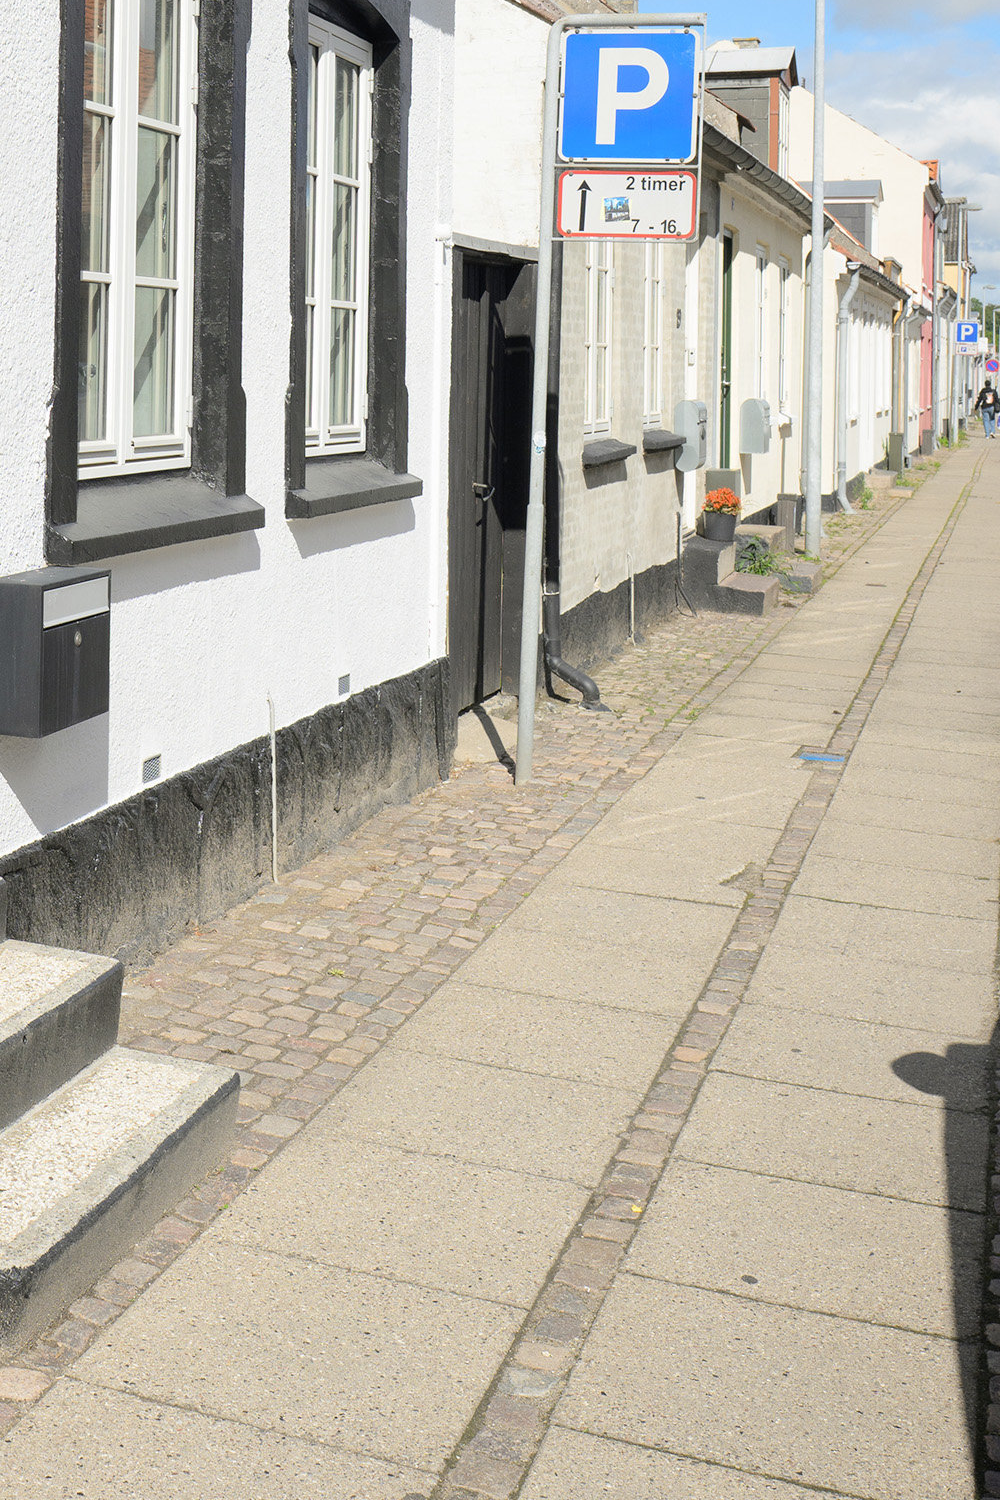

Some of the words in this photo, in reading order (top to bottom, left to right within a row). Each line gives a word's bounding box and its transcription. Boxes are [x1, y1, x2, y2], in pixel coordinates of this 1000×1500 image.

[595, 47, 669, 145] P
[626, 176, 635, 190] 2
[641, 176, 685, 191] timer
[631, 219, 640, 232] 7
[661, 219, 676, 234] 16
[961, 325, 974, 340] P
